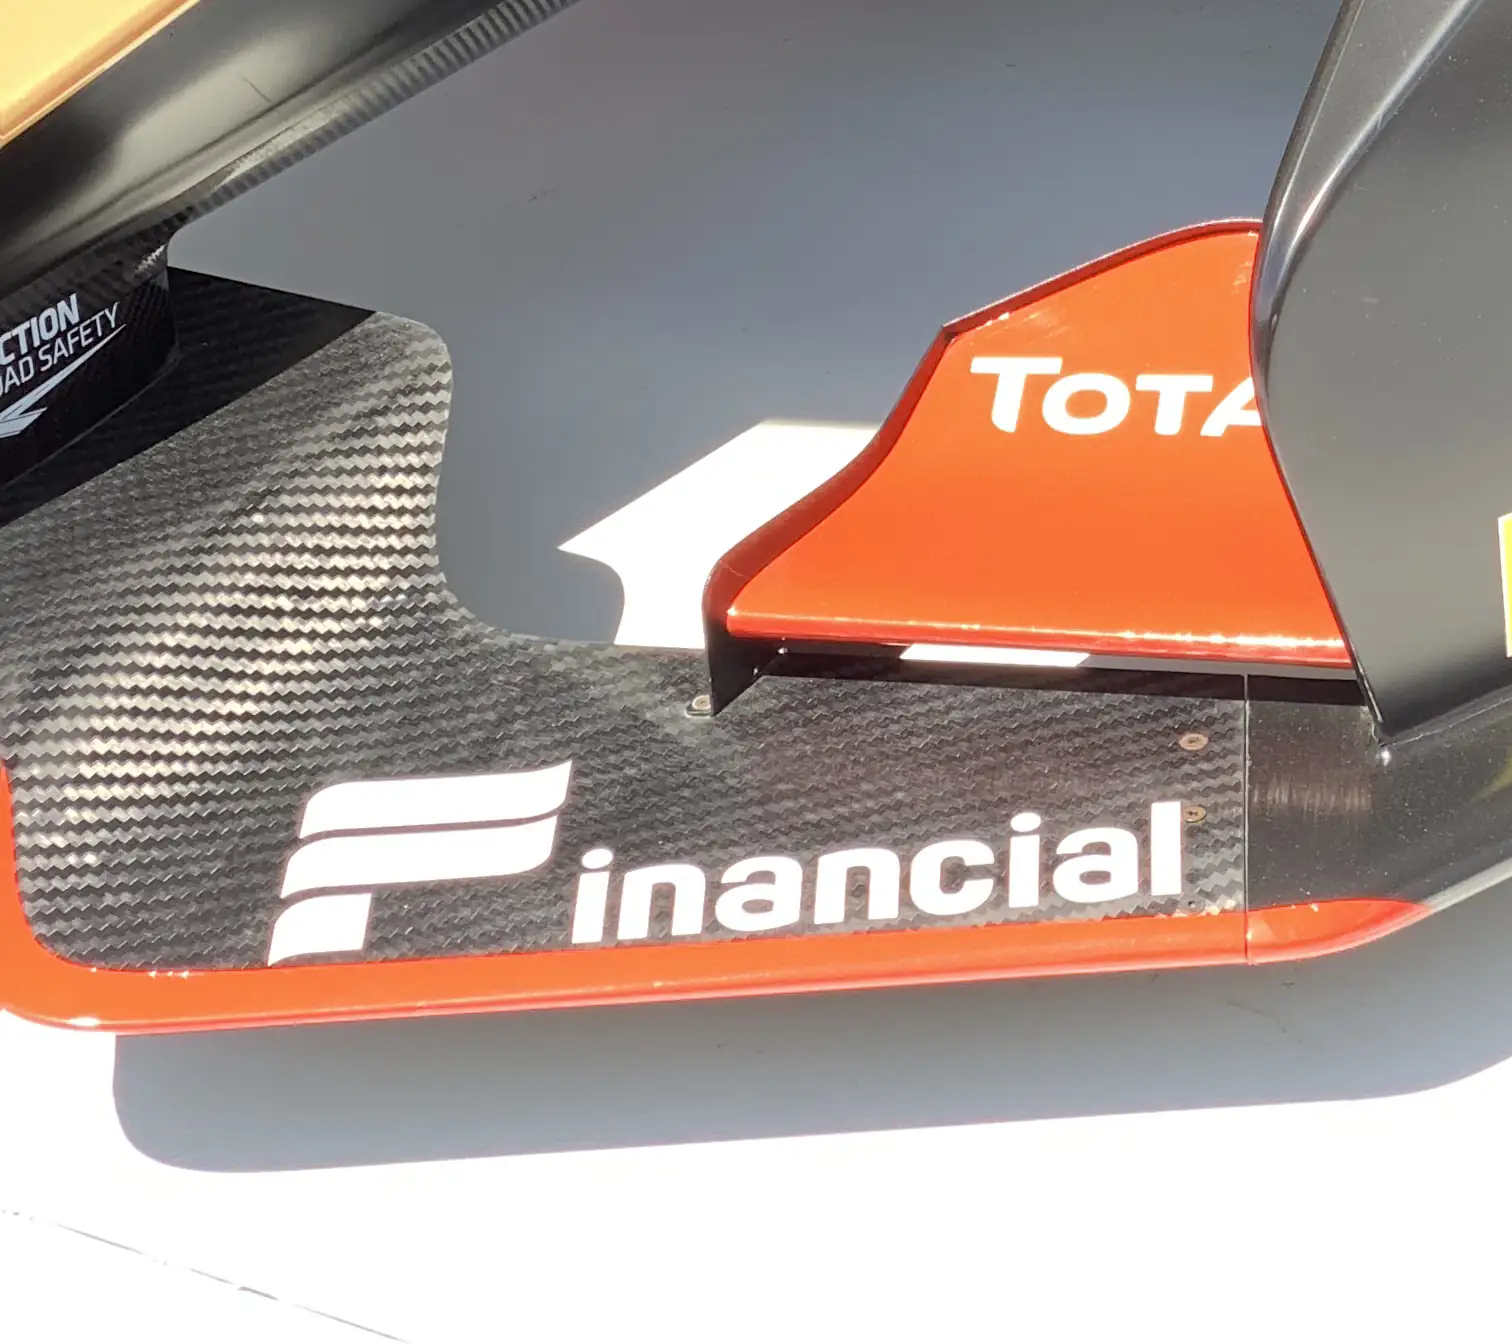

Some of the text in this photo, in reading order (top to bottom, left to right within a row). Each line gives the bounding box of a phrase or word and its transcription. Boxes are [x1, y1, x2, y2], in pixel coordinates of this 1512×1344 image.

[0, 301, 120, 397] AD SAFETY
[266, 757, 1183, 968] Financial
